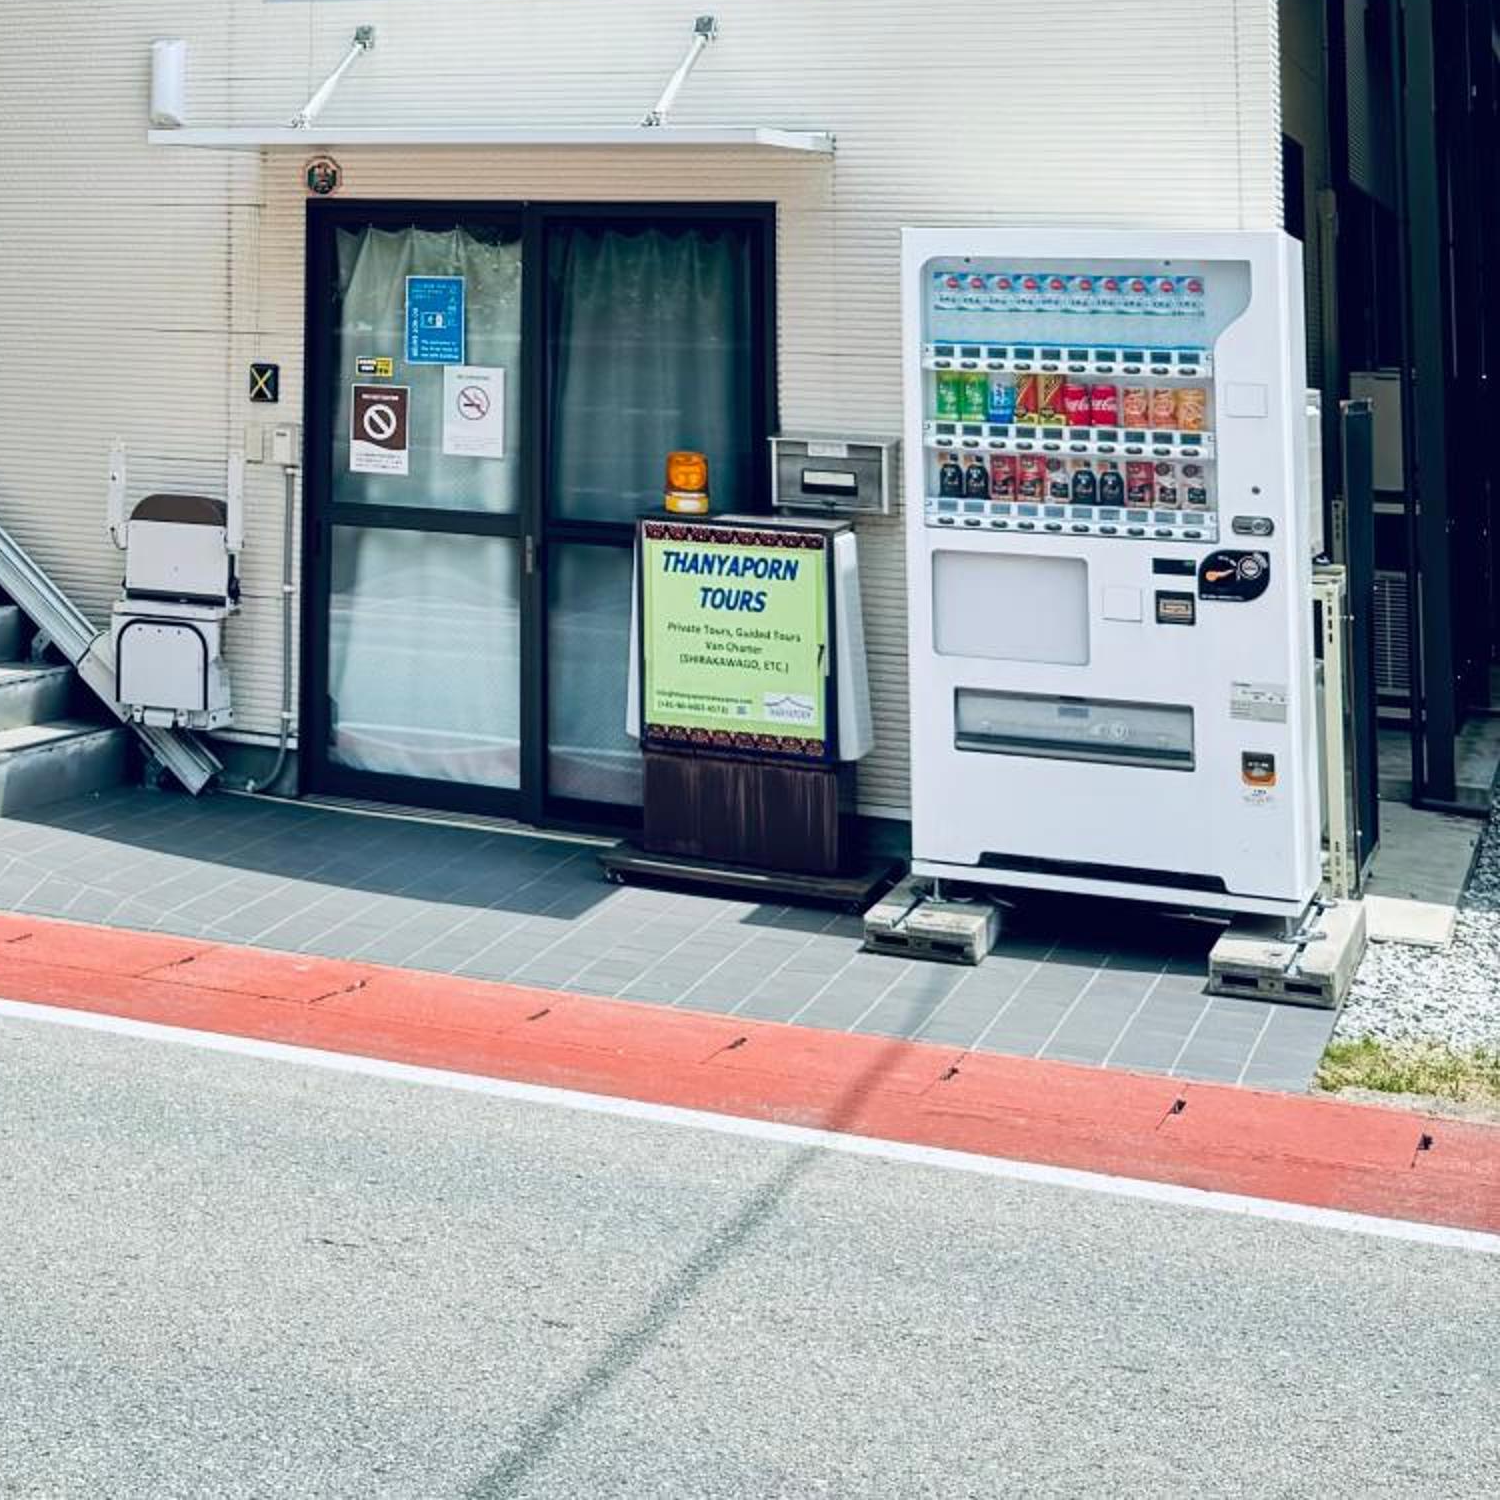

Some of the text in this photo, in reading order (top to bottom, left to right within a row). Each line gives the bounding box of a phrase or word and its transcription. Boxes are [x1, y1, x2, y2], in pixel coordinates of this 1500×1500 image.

[662, 550, 799, 581] THANYAPORN
[700, 586, 768, 613] TOURS
[667, 621, 802, 643] Private Tours, Guided Tours
[705, 641, 763, 654] Van Charter
